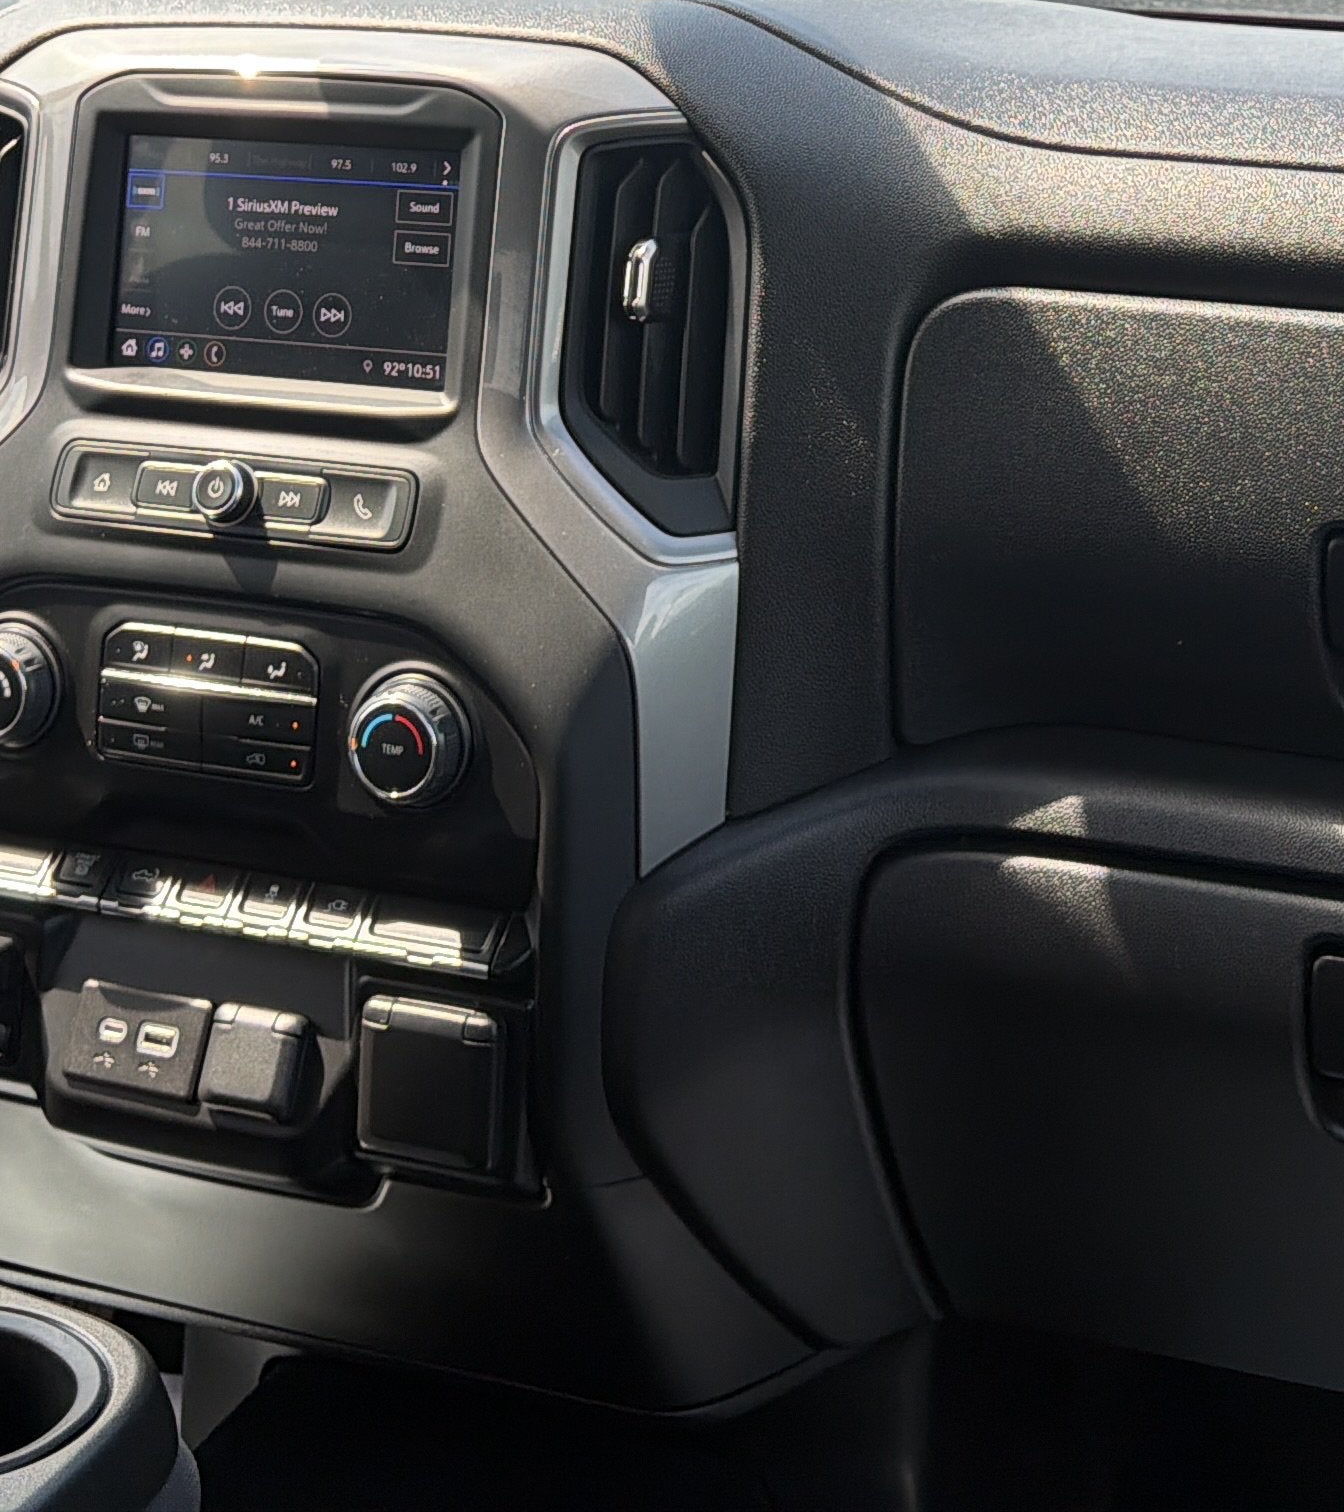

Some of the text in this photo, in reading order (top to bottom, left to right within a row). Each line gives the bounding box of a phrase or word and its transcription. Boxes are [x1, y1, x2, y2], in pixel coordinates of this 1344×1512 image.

[209, 152, 229, 164] 95.3
[330, 158, 352, 170] 97.5
[391, 162, 418, 174] 102.9
[227, 197, 339, 217] 1 SiriusXM Preview
[409, 201, 440, 214] Sound
[135, 225, 150, 237] FM
[234, 218, 328, 235] Great Offer Now!
[242, 236, 319, 252] 844-711-8800
[404, 241, 440, 255] Browse
[121, 303, 146, 316] More
[271, 305, 294, 318] Tune
[248, 714, 264, 727] A/C
[381, 742, 404, 756] TEMP
